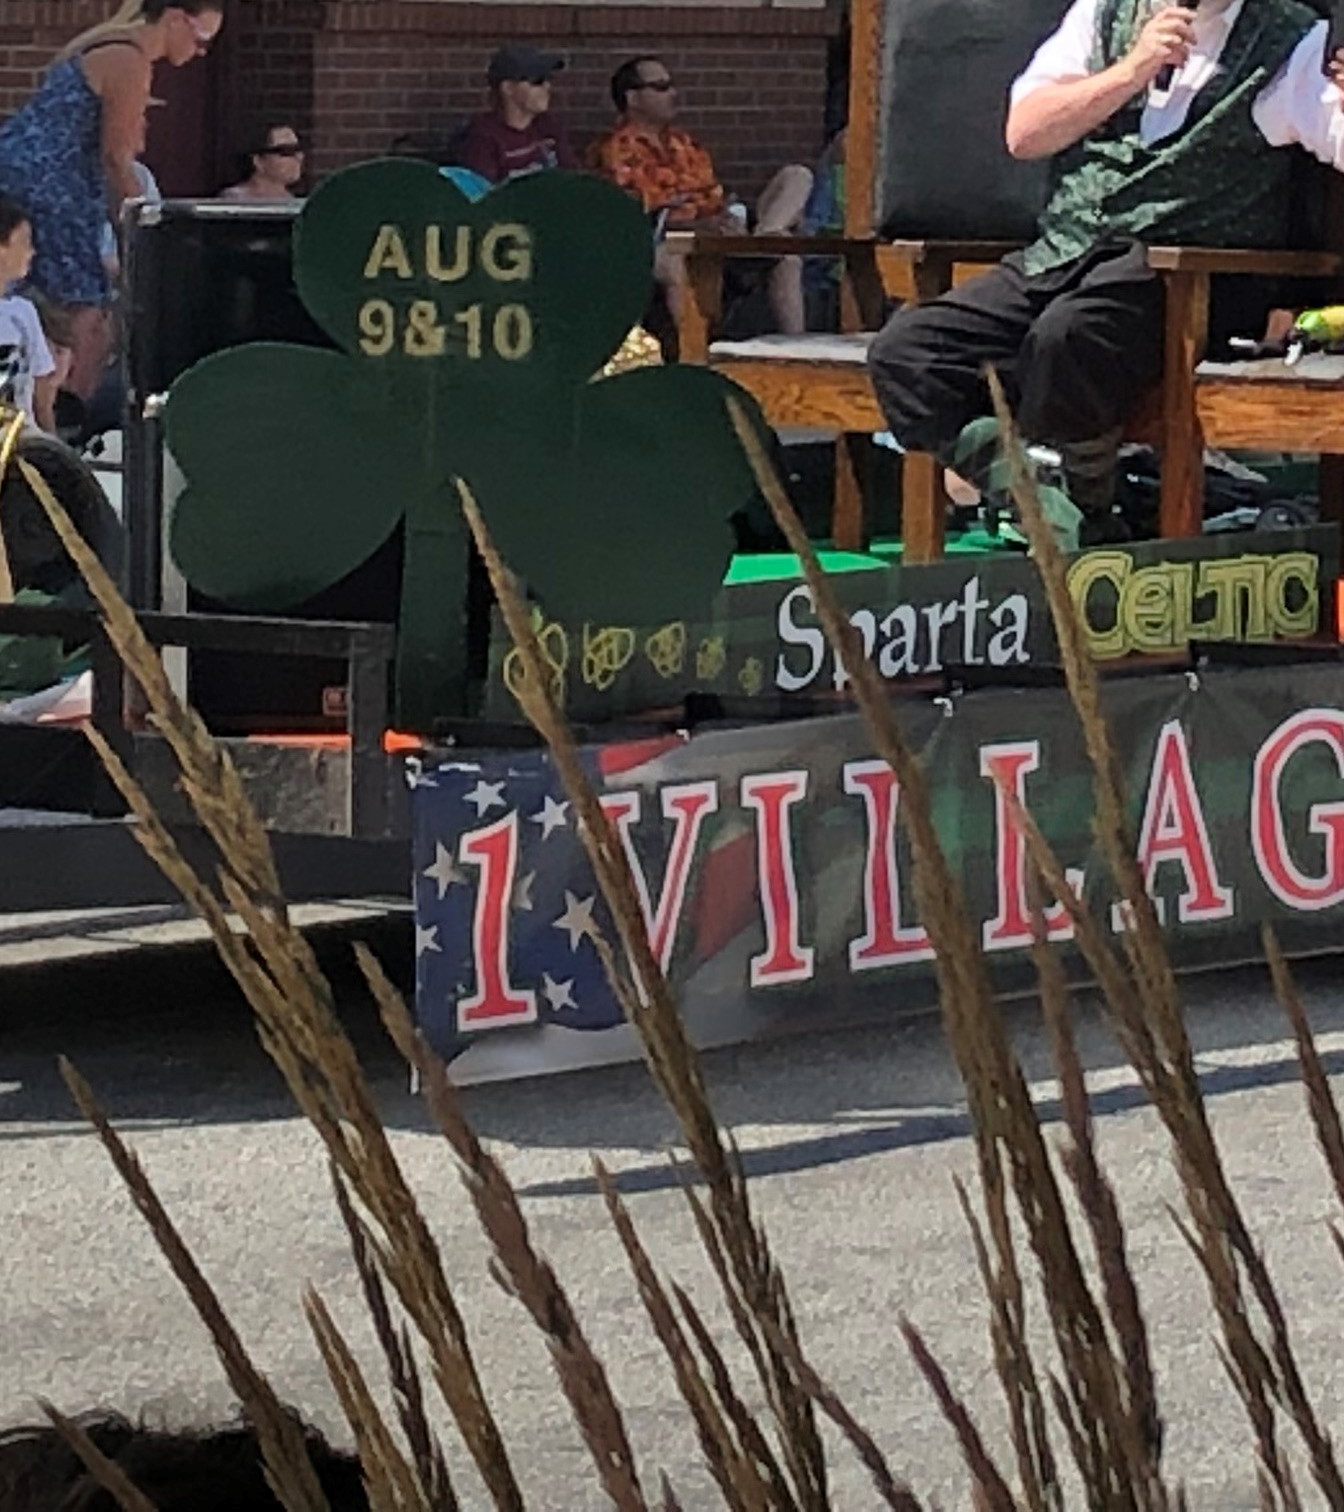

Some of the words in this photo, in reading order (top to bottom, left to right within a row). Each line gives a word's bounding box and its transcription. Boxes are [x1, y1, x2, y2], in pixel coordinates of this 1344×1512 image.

[364, 223, 535, 282] AUG
[358, 299, 535, 360] 9&10
[776, 575, 1031, 691] Sparta
[457, 810, 538, 1032] 1
